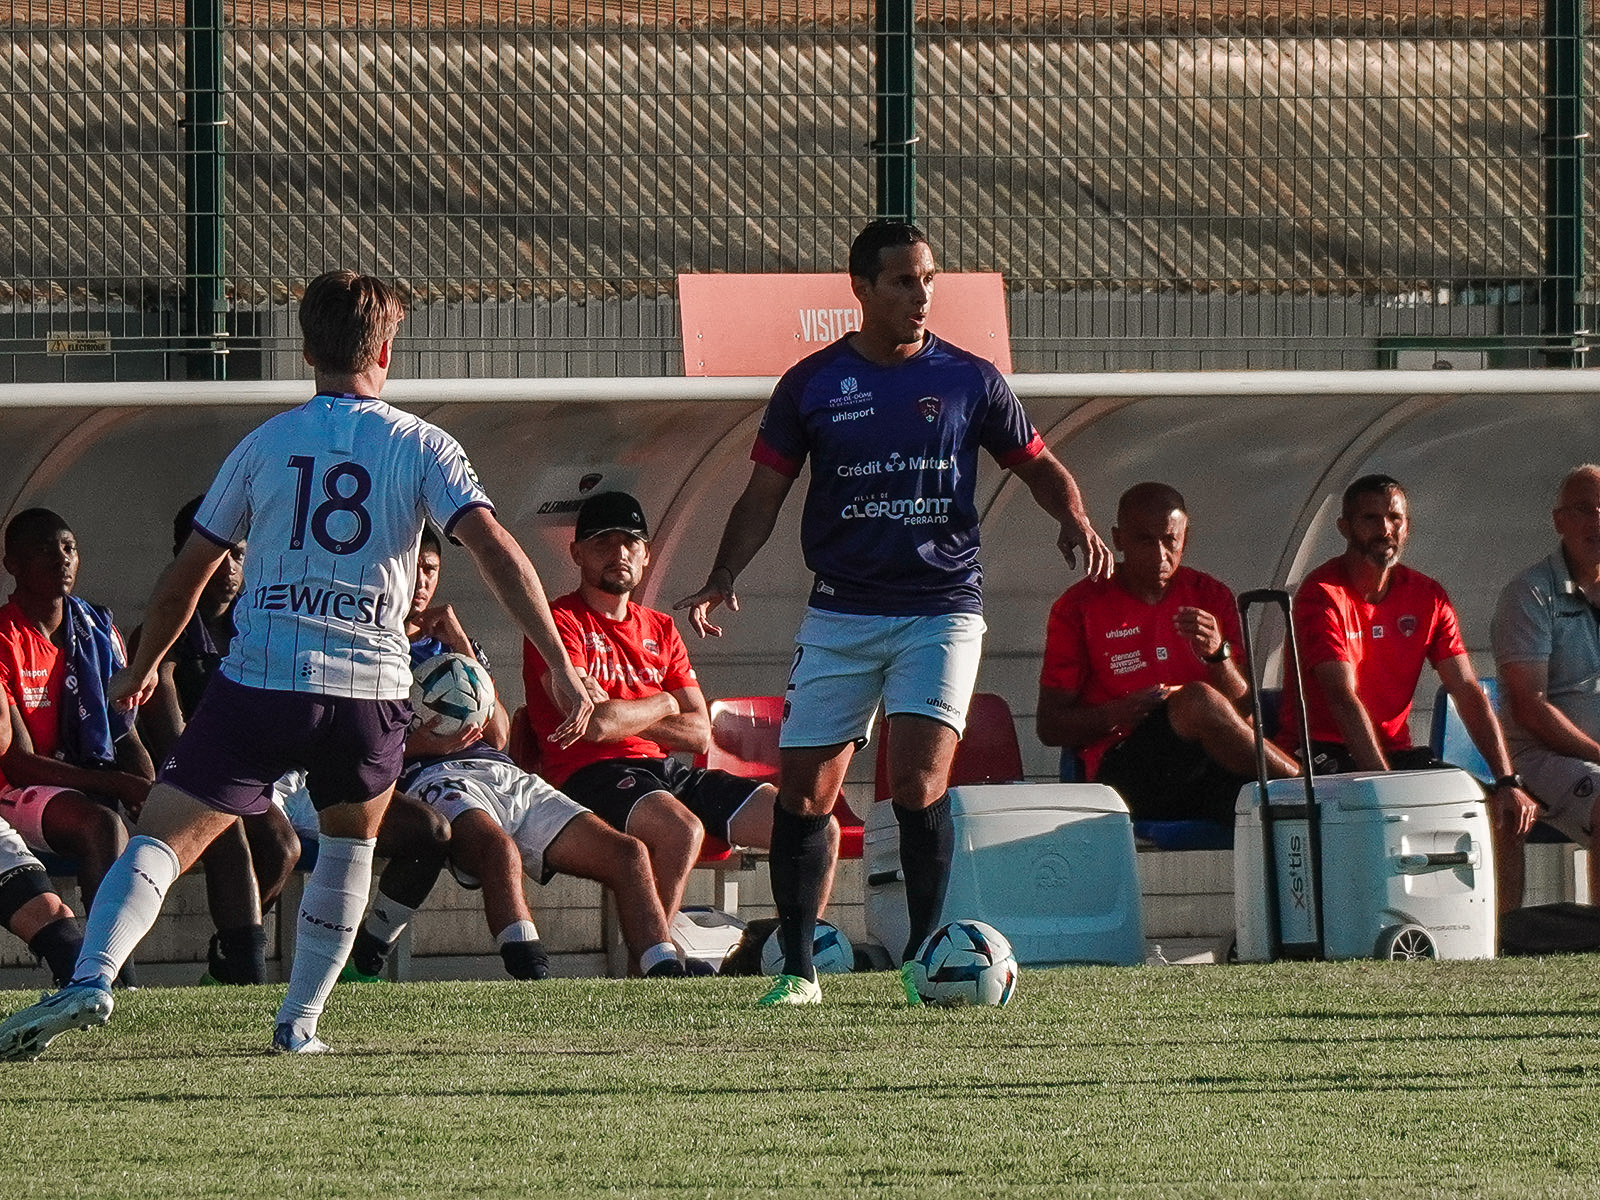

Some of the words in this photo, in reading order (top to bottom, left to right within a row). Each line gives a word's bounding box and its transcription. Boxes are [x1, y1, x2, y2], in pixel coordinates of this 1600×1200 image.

[832, 406, 875, 423] uhlsport
[837, 460, 882, 477] Crédit
[909, 456, 957, 470] Mutuel
[286, 454, 373, 556] 18
[1105, 626, 1141, 639] uhlsport
